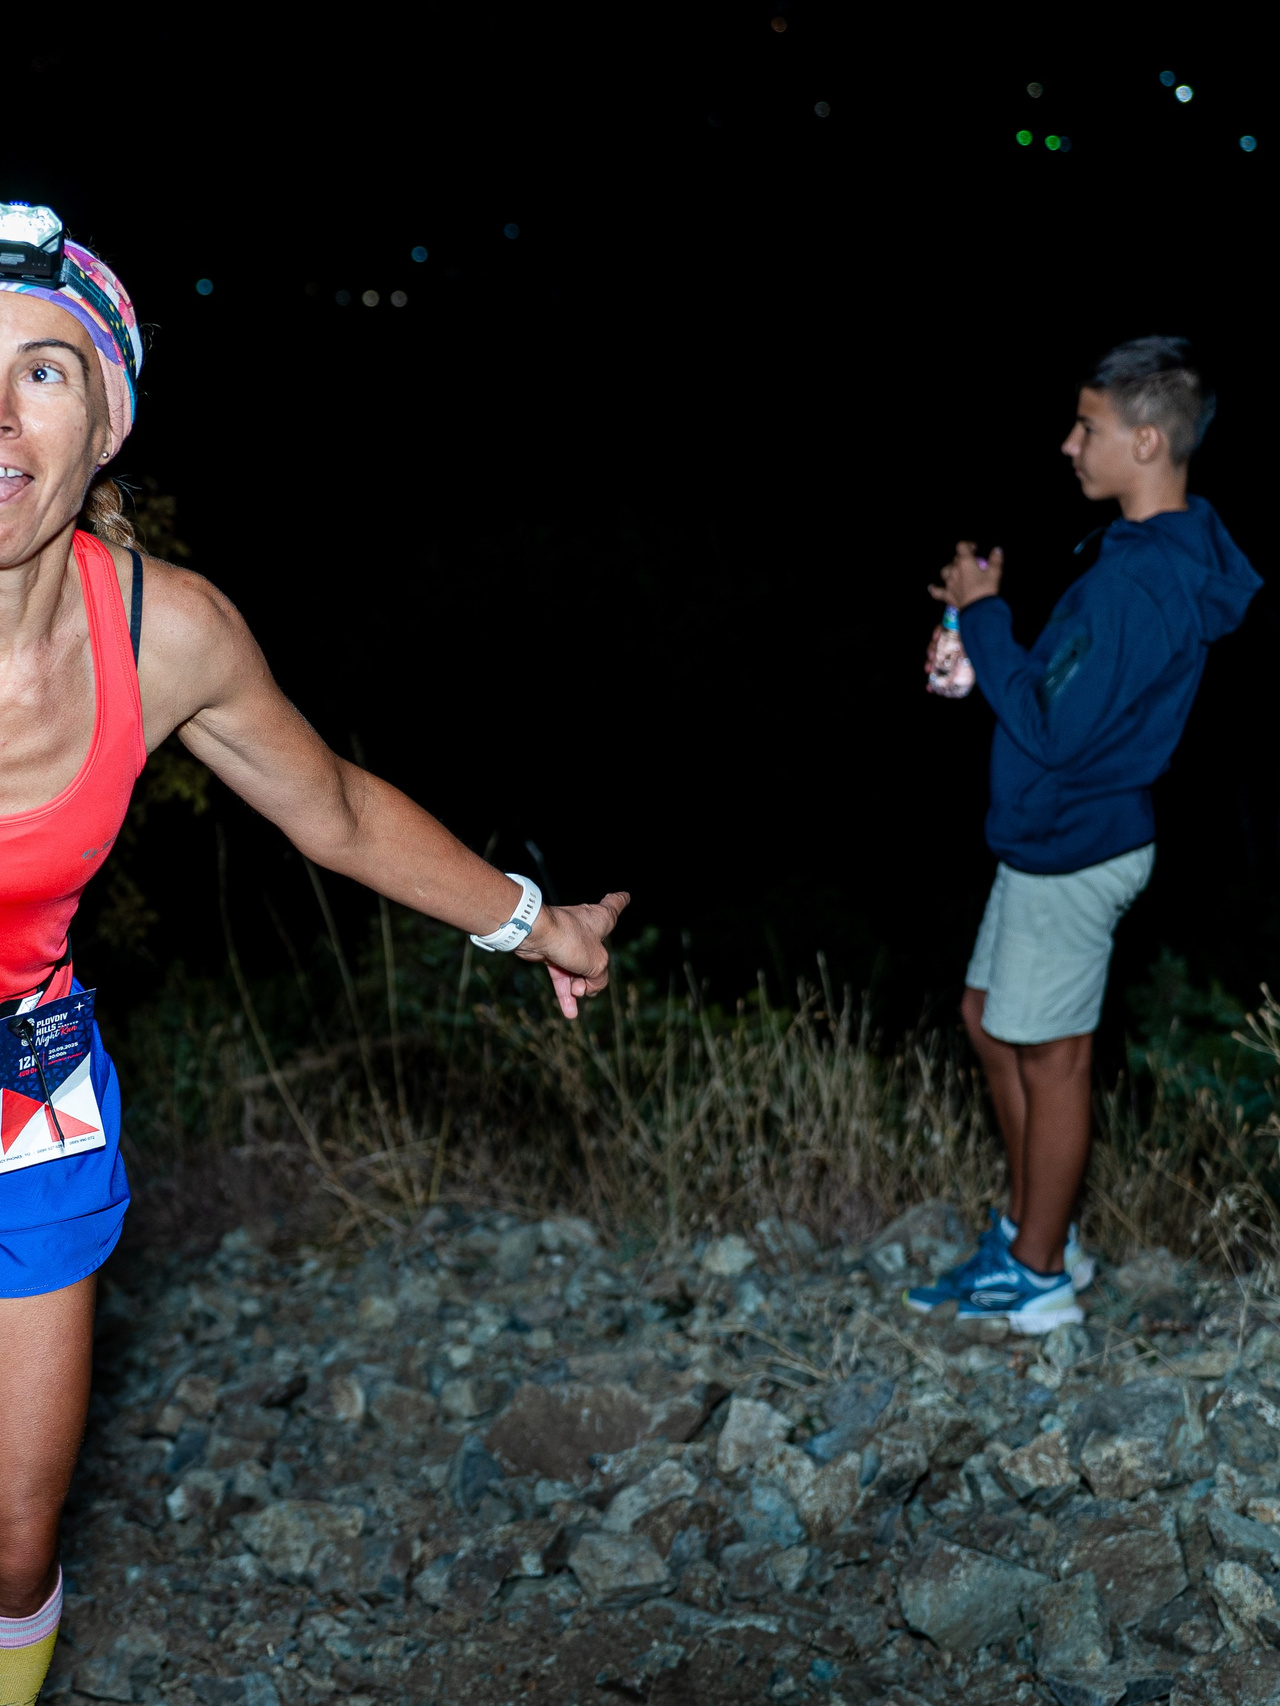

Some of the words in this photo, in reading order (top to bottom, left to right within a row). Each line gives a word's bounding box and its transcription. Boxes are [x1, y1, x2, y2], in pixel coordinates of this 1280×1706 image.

[36, 1012, 69, 1029] PLOVDIV
[35, 1029, 61, 1047] Night
[59, 1025, 78, 1036] Run
[36, 1023, 57, 1036] HILLS
